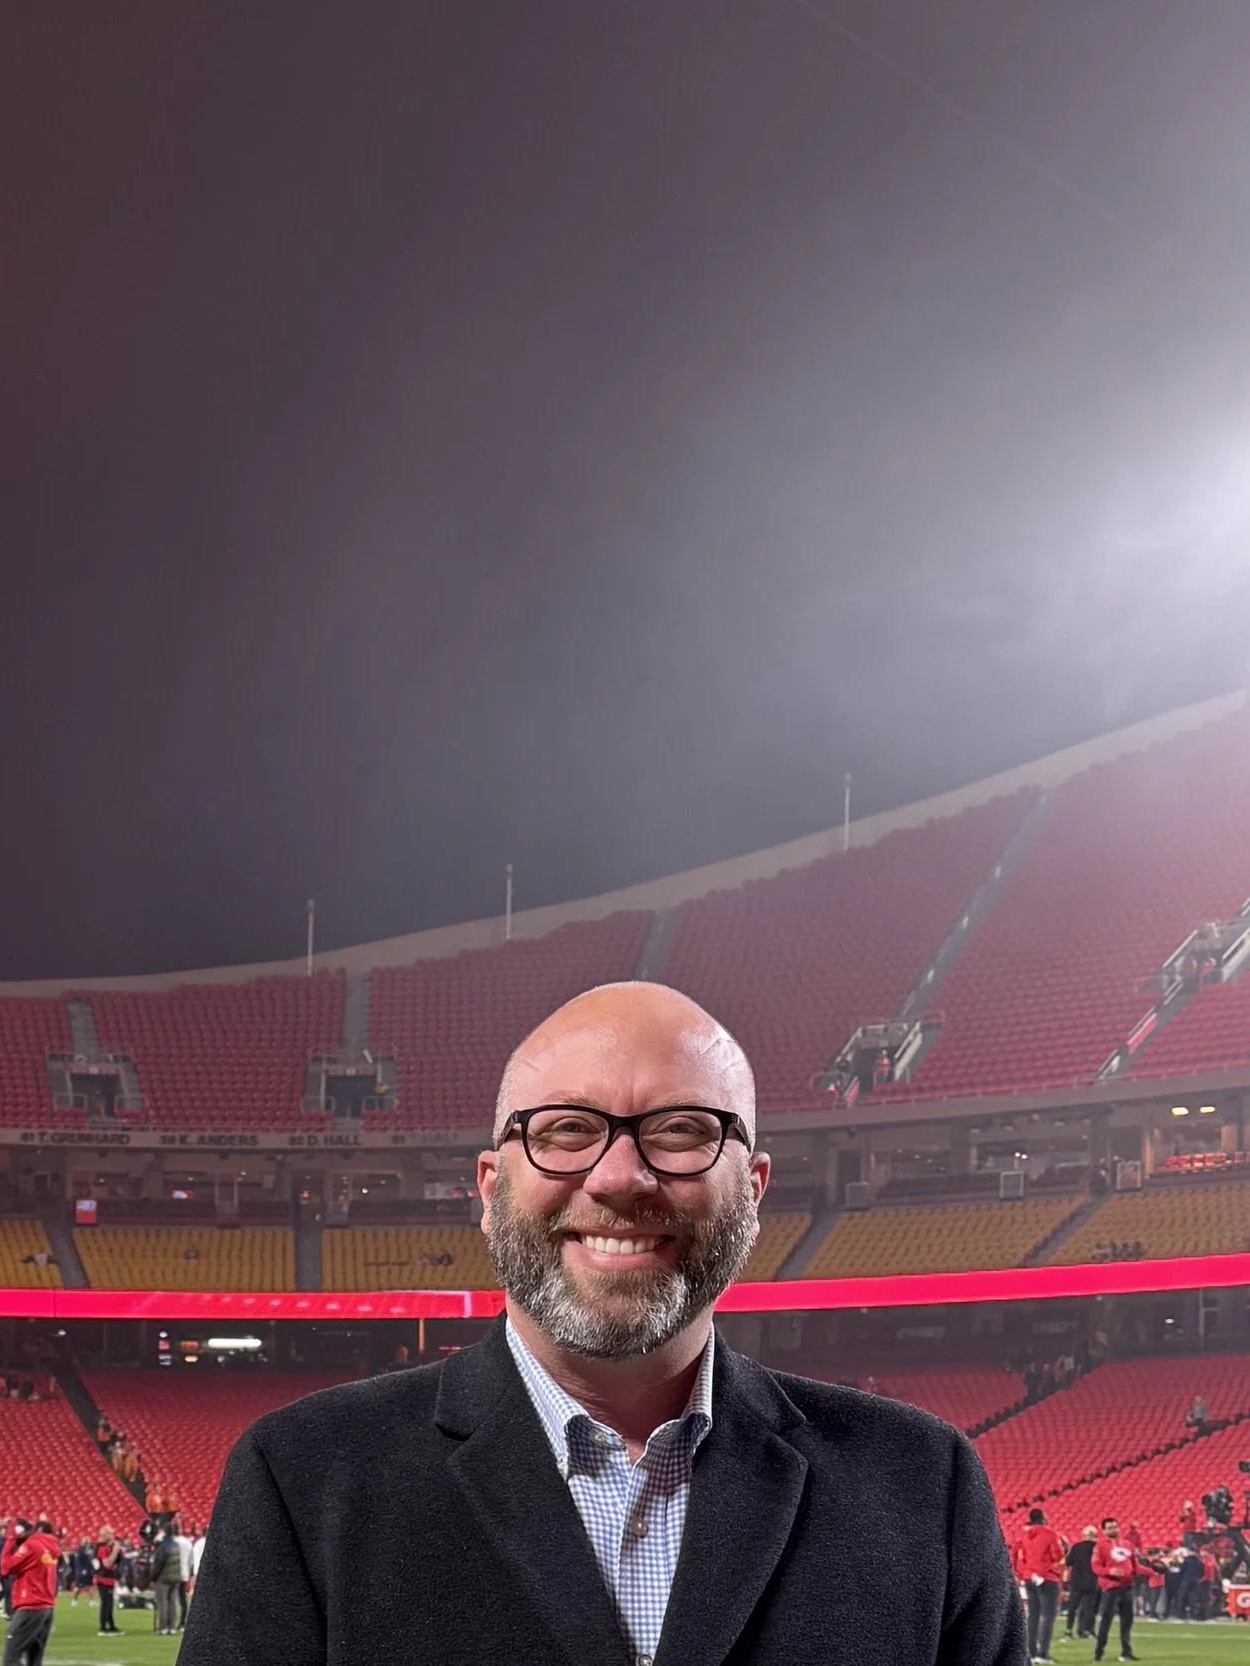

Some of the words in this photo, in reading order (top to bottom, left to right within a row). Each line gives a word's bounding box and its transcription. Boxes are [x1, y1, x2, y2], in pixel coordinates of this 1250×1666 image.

[50, 1132, 131, 1146] GRUNHARD
[197, 1134, 259, 1147] ANDERS
[324, 1134, 363, 1147] HALL
